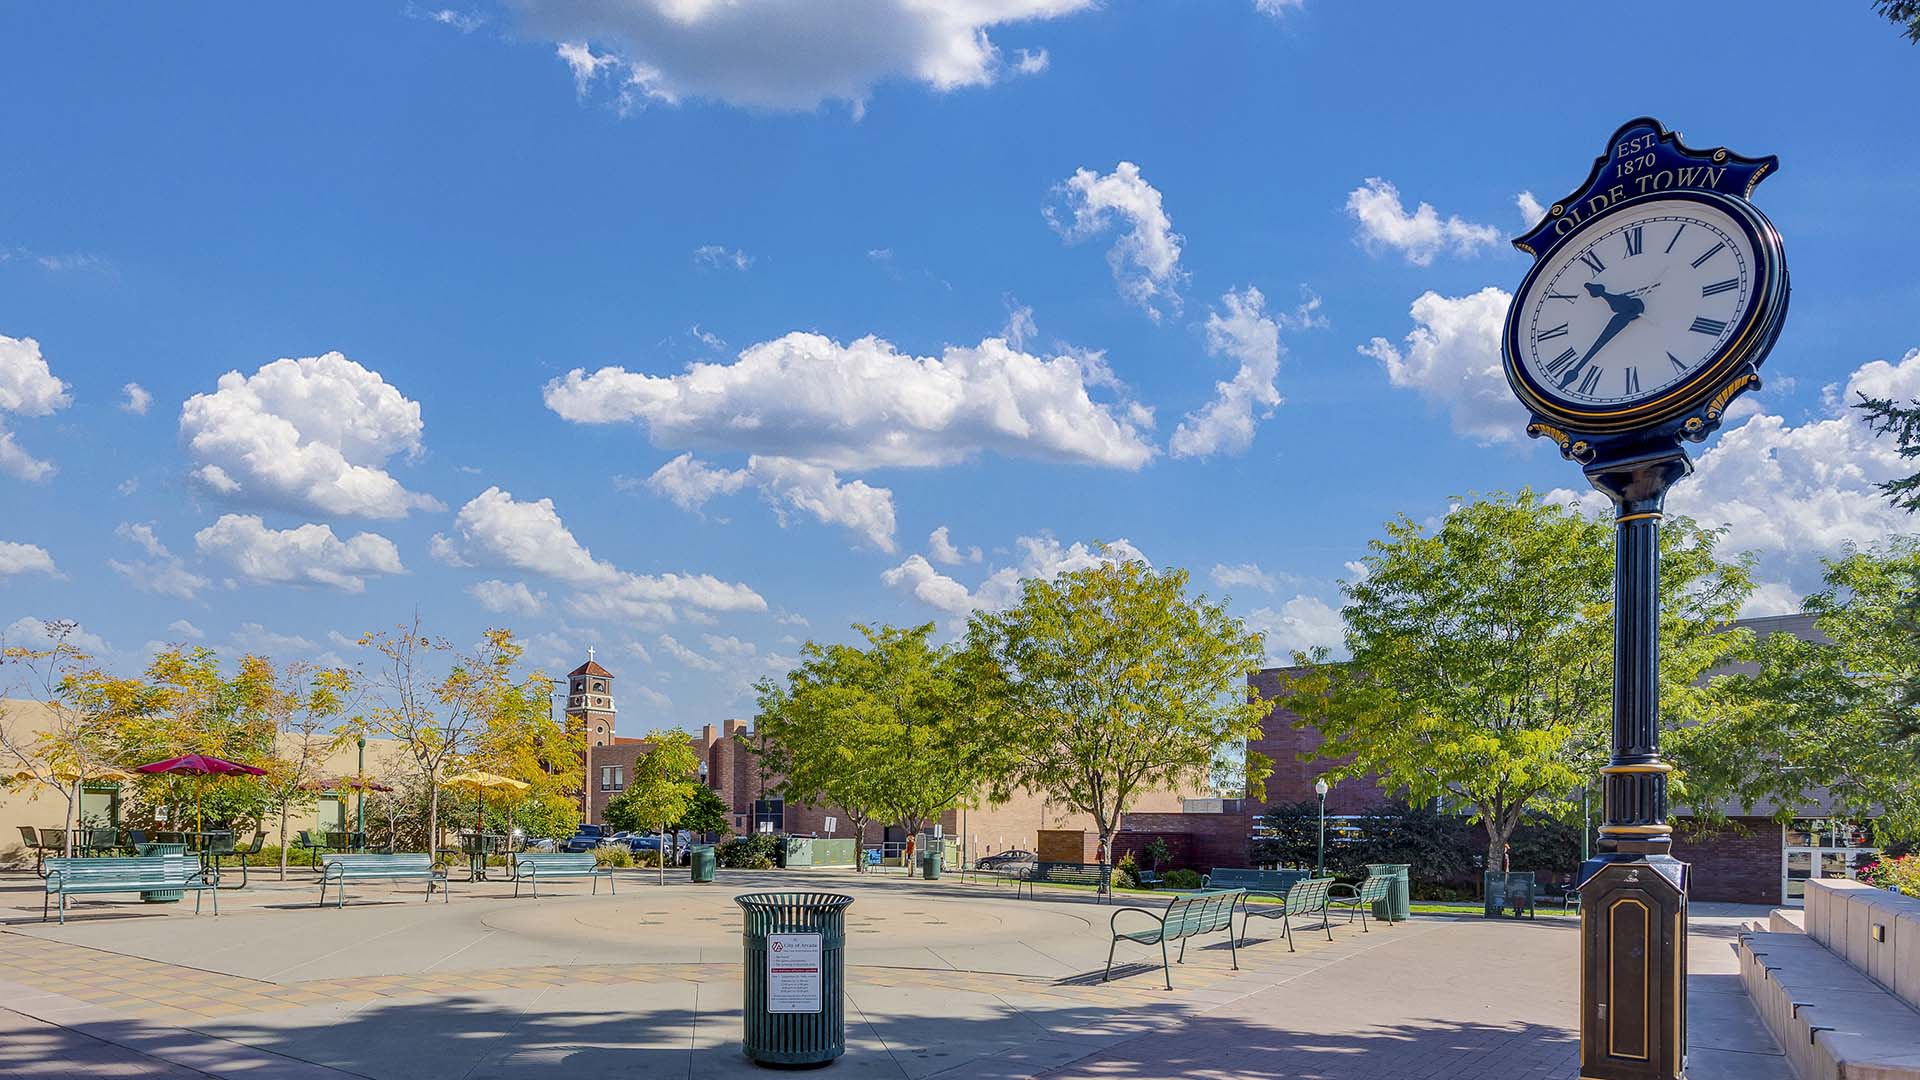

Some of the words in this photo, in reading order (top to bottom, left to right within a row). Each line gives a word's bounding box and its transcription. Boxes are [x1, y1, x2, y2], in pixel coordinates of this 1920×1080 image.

[1616, 133, 1656, 158] EST.
[1616, 153, 1657, 178] 1870
[1555, 184, 1627, 236] OLDE
[1635, 167, 1728, 193] TOWN
